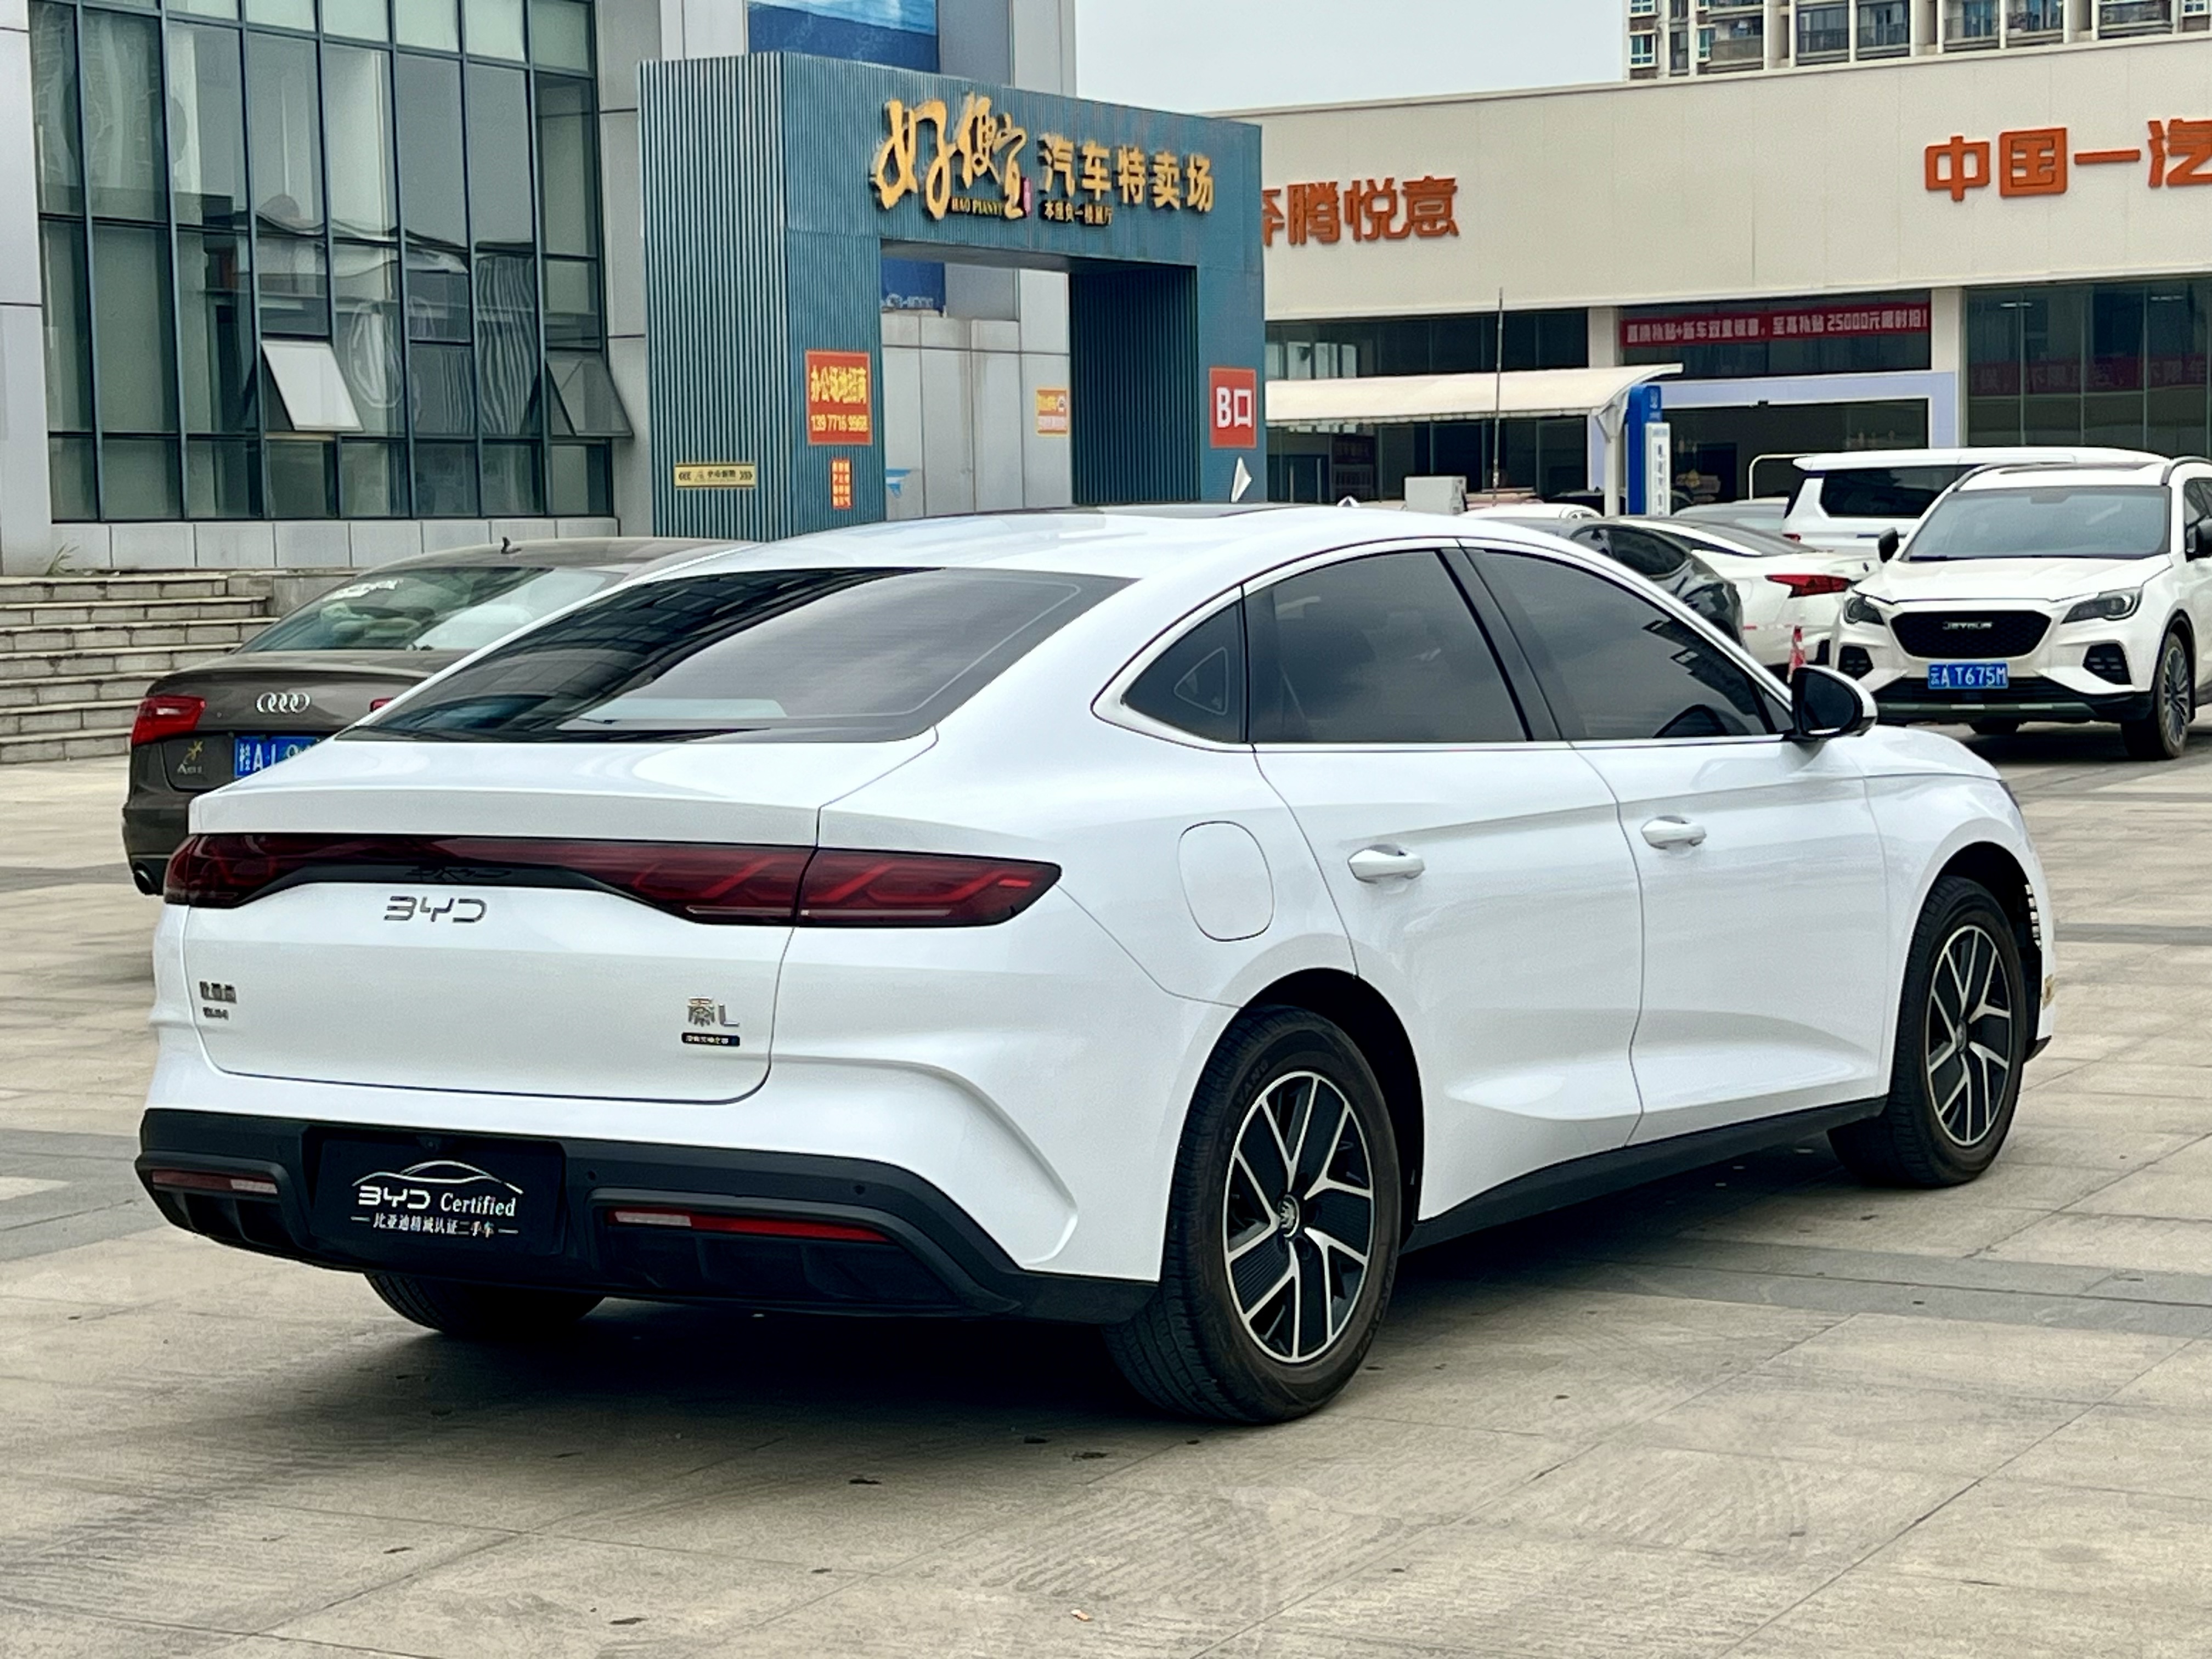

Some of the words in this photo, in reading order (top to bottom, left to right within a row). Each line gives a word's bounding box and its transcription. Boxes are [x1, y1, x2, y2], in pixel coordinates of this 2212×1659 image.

[1039, 133, 1214, 212] 汽车特卖场
[1925, 117, 2212, 203] 中国一汽
[811, 415, 826, 431] 139
[1216, 386, 1252, 428] B口
[383, 896, 487, 923] BYD
[358, 1185, 431, 1210] BYD
[440, 1192, 516, 1217] Certified
